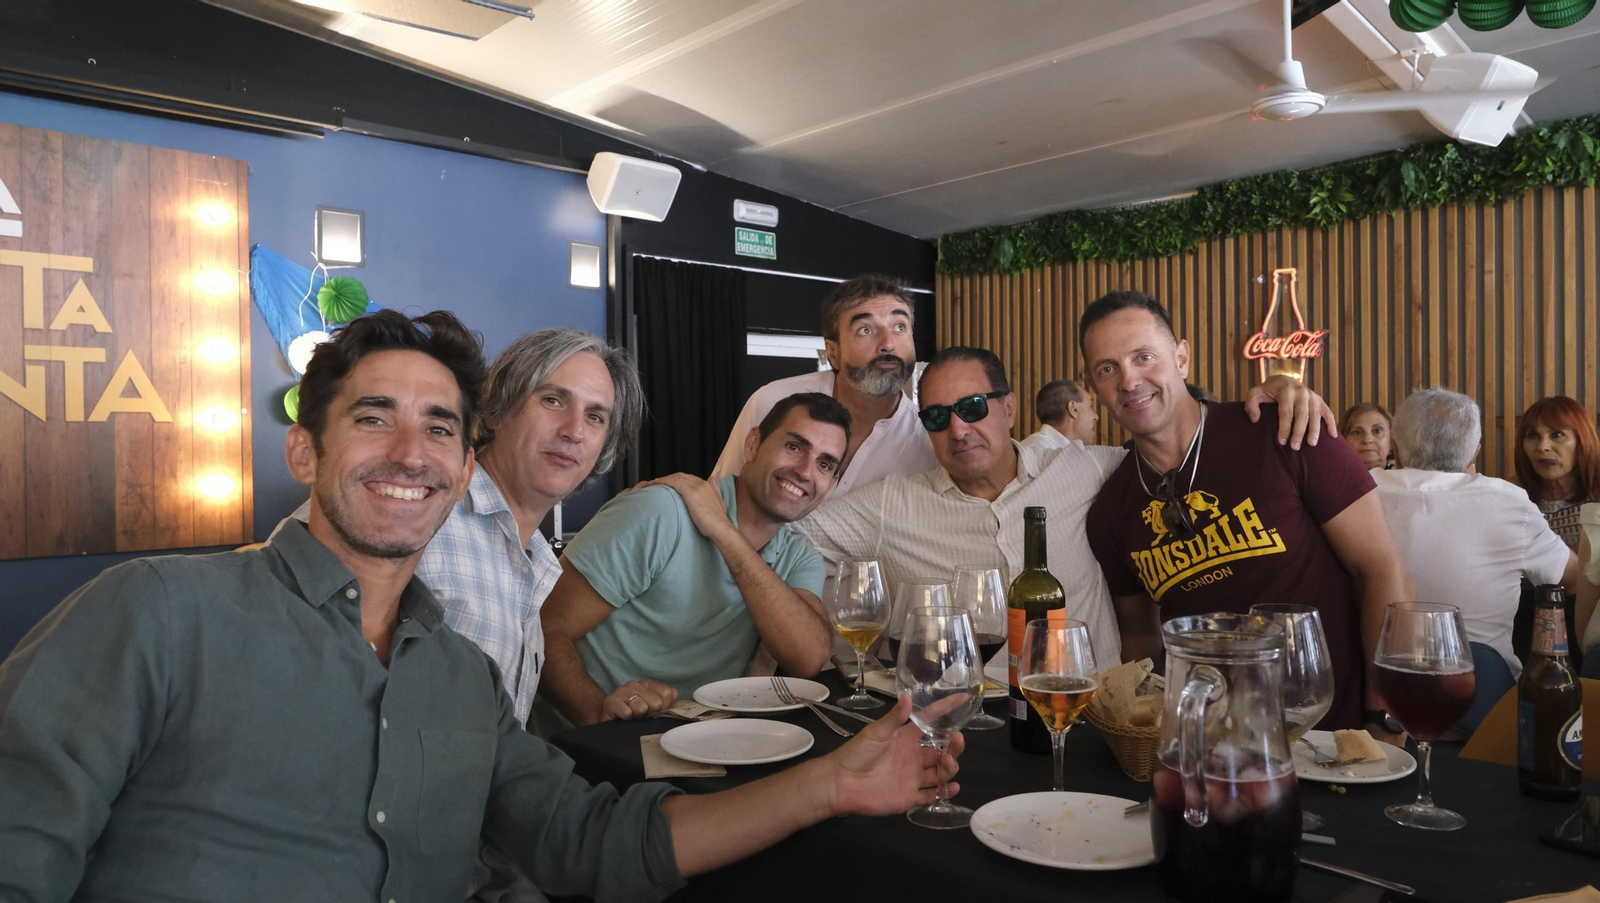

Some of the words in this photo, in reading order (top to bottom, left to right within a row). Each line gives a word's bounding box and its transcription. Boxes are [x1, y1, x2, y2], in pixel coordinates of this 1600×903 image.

[739, 231, 759, 242] SALIDA
[764, 235, 773, 245] DE
[738, 242, 774, 256] EMERGENCIA
[1243, 329, 1325, 360] Coca-Cola
[1180, 566, 1234, 592] LONDON
